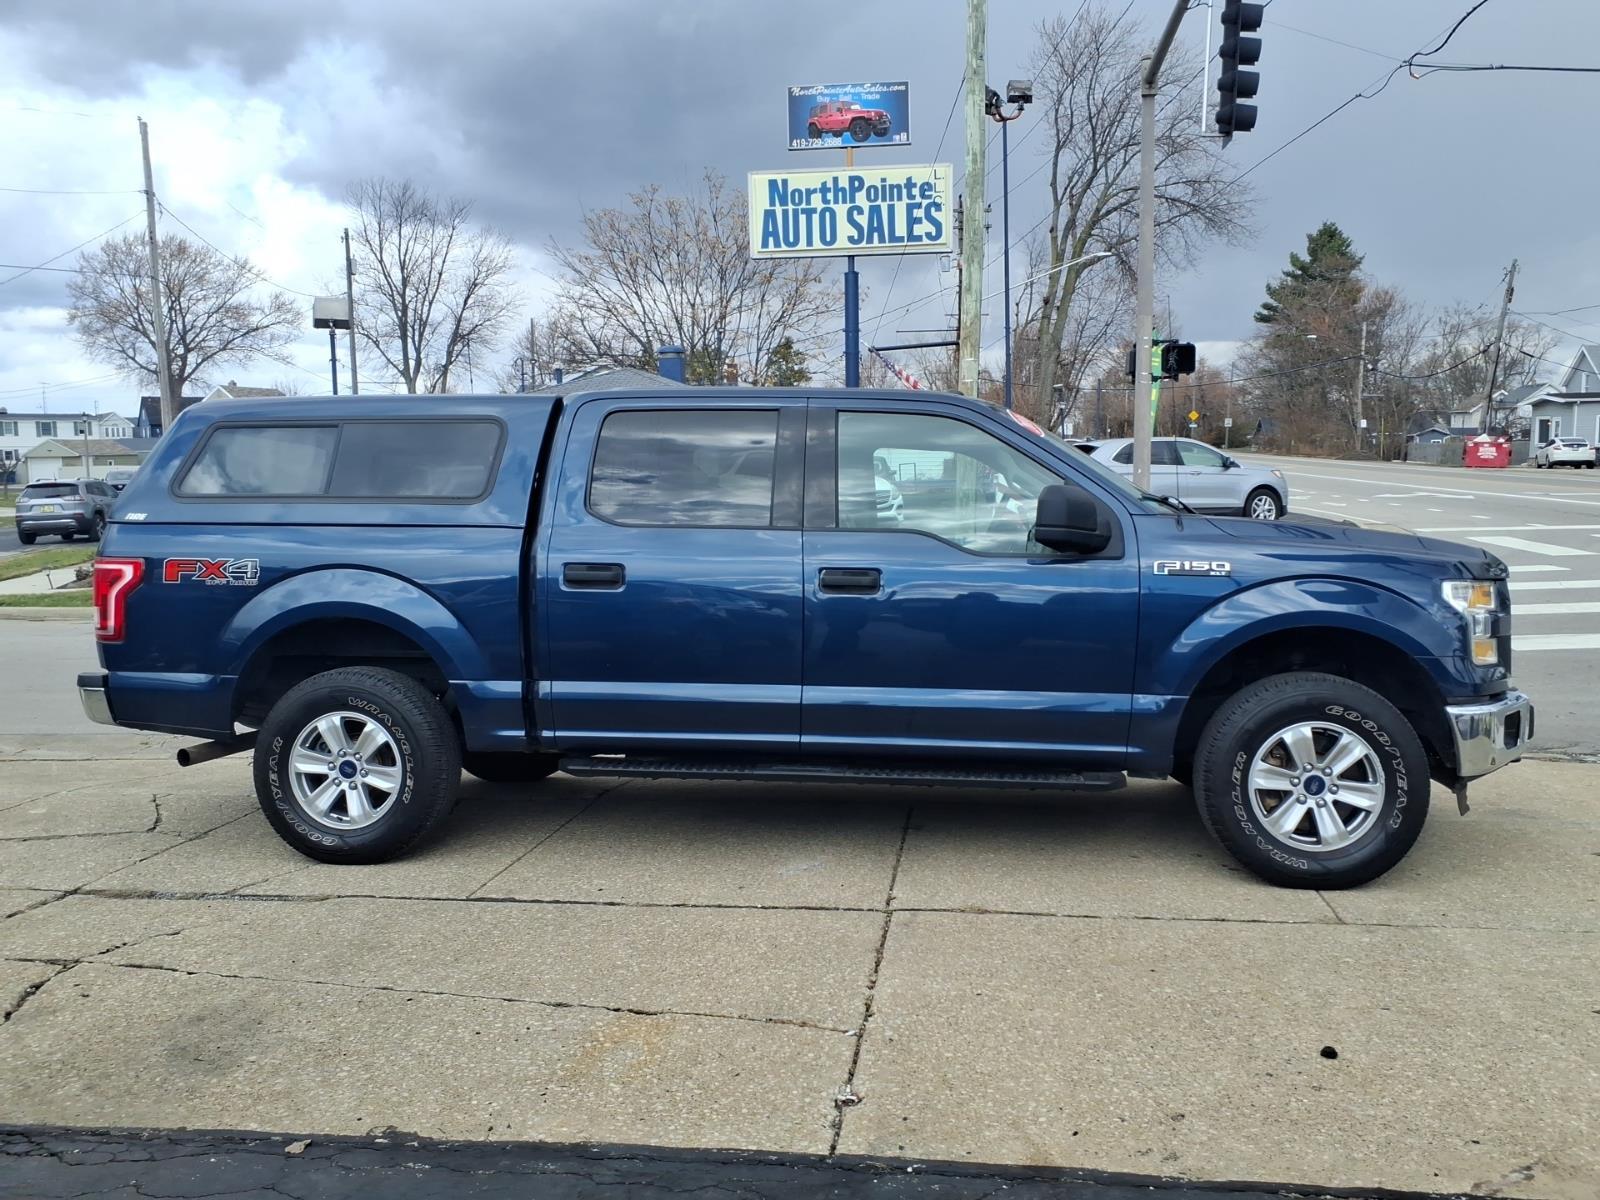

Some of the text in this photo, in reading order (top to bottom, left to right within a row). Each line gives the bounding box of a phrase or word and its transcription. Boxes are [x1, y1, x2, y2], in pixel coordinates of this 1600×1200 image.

[791, 83, 906, 96] NorthPointeAutoSales.com
[761, 201, 943, 249] AUTO SALES
[768, 175, 934, 208] NorthPointe
[163, 558, 260, 583] FX4
[348, 697, 415, 804] WRANGLER
[1325, 705, 1408, 829] GOODYEAR
[269, 736, 338, 846] GOODYEAR
[1231, 751, 1309, 870] WRANGLER
